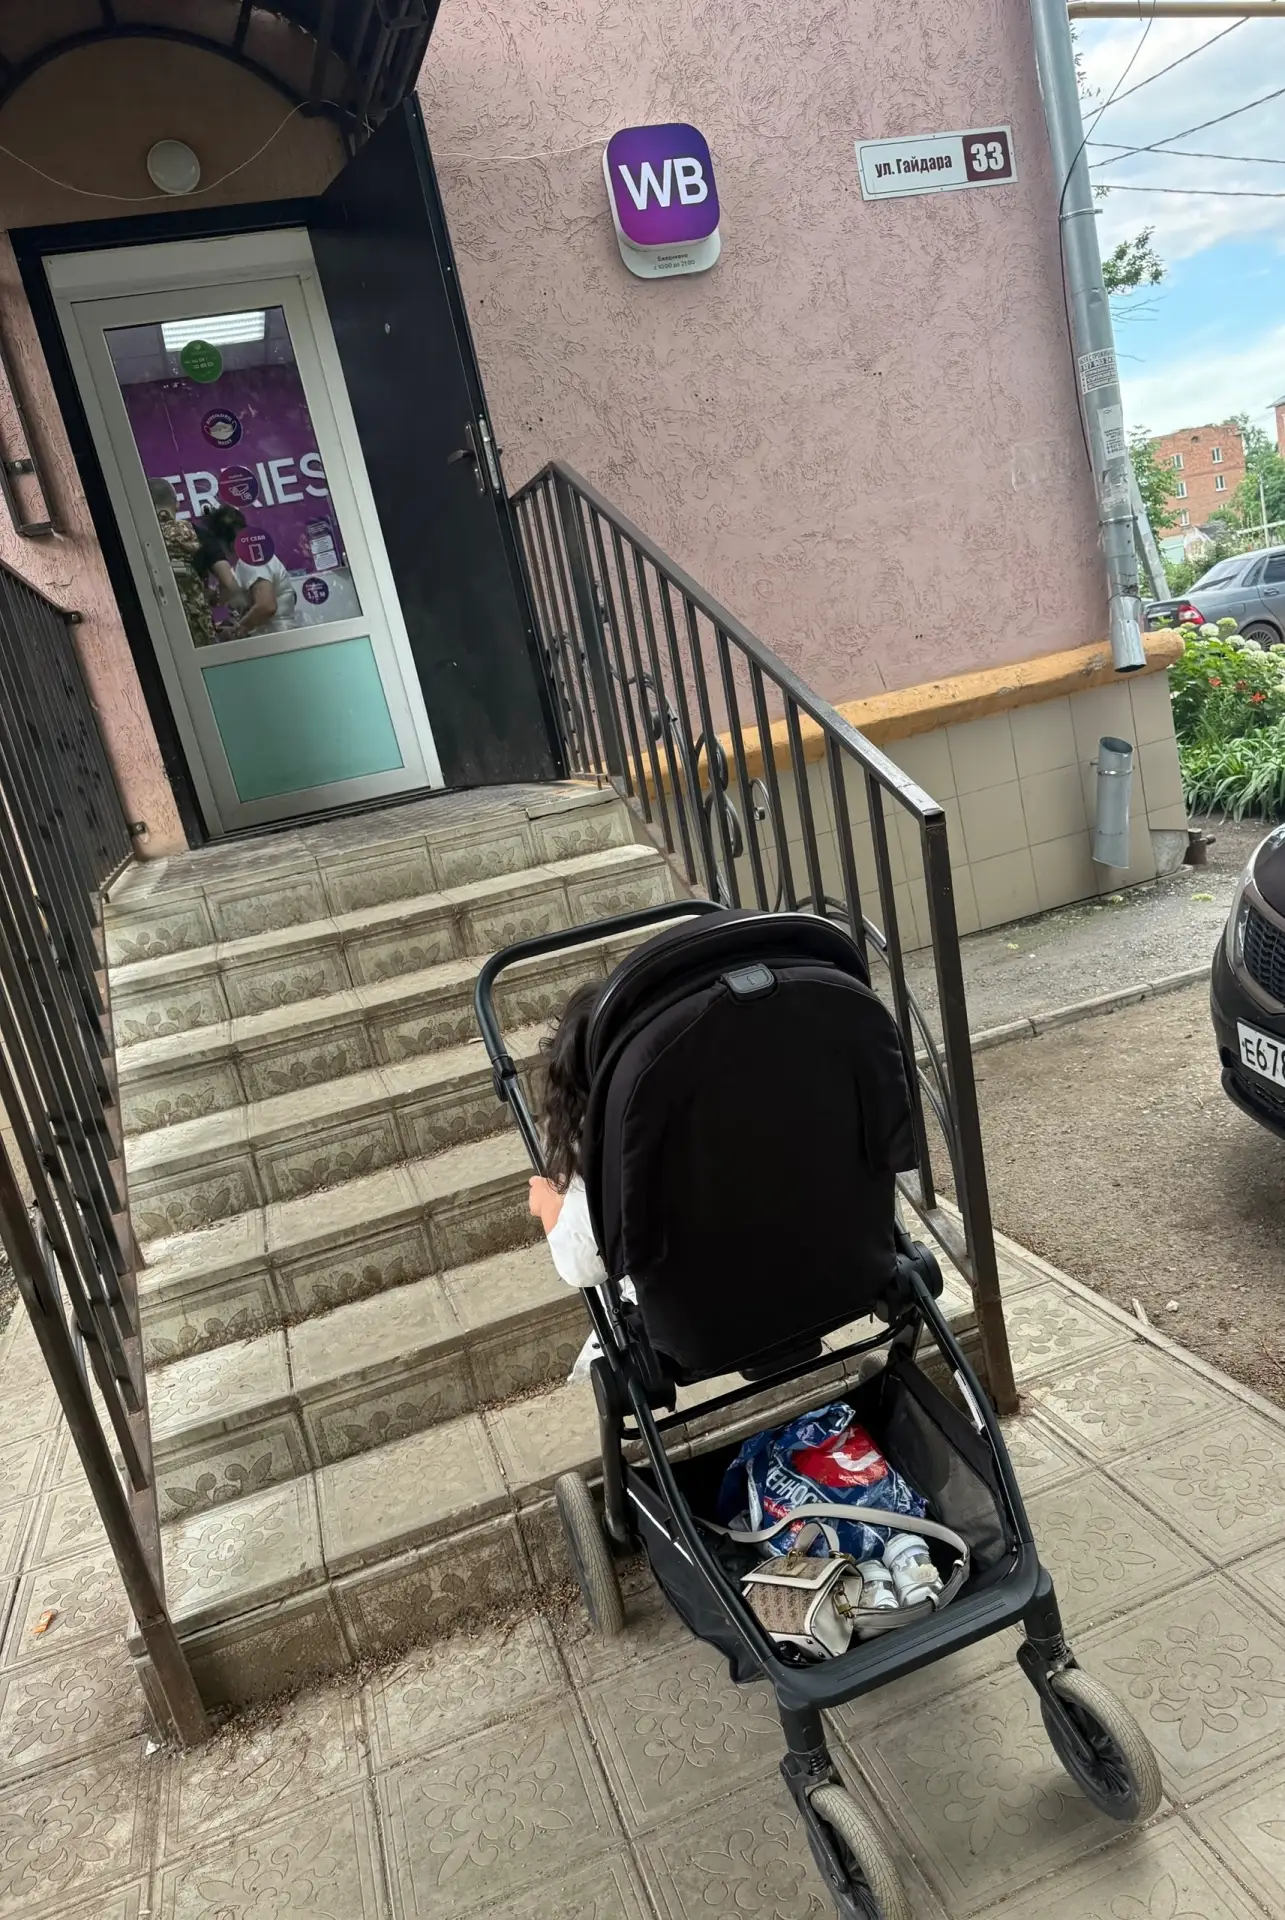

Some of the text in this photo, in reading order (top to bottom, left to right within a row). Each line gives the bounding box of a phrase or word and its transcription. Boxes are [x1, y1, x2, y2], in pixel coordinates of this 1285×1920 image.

[618, 156, 709, 210] WB
[875, 141, 1005, 178] ул. Гайдара 33
[162, 452, 329, 521] ERIES
